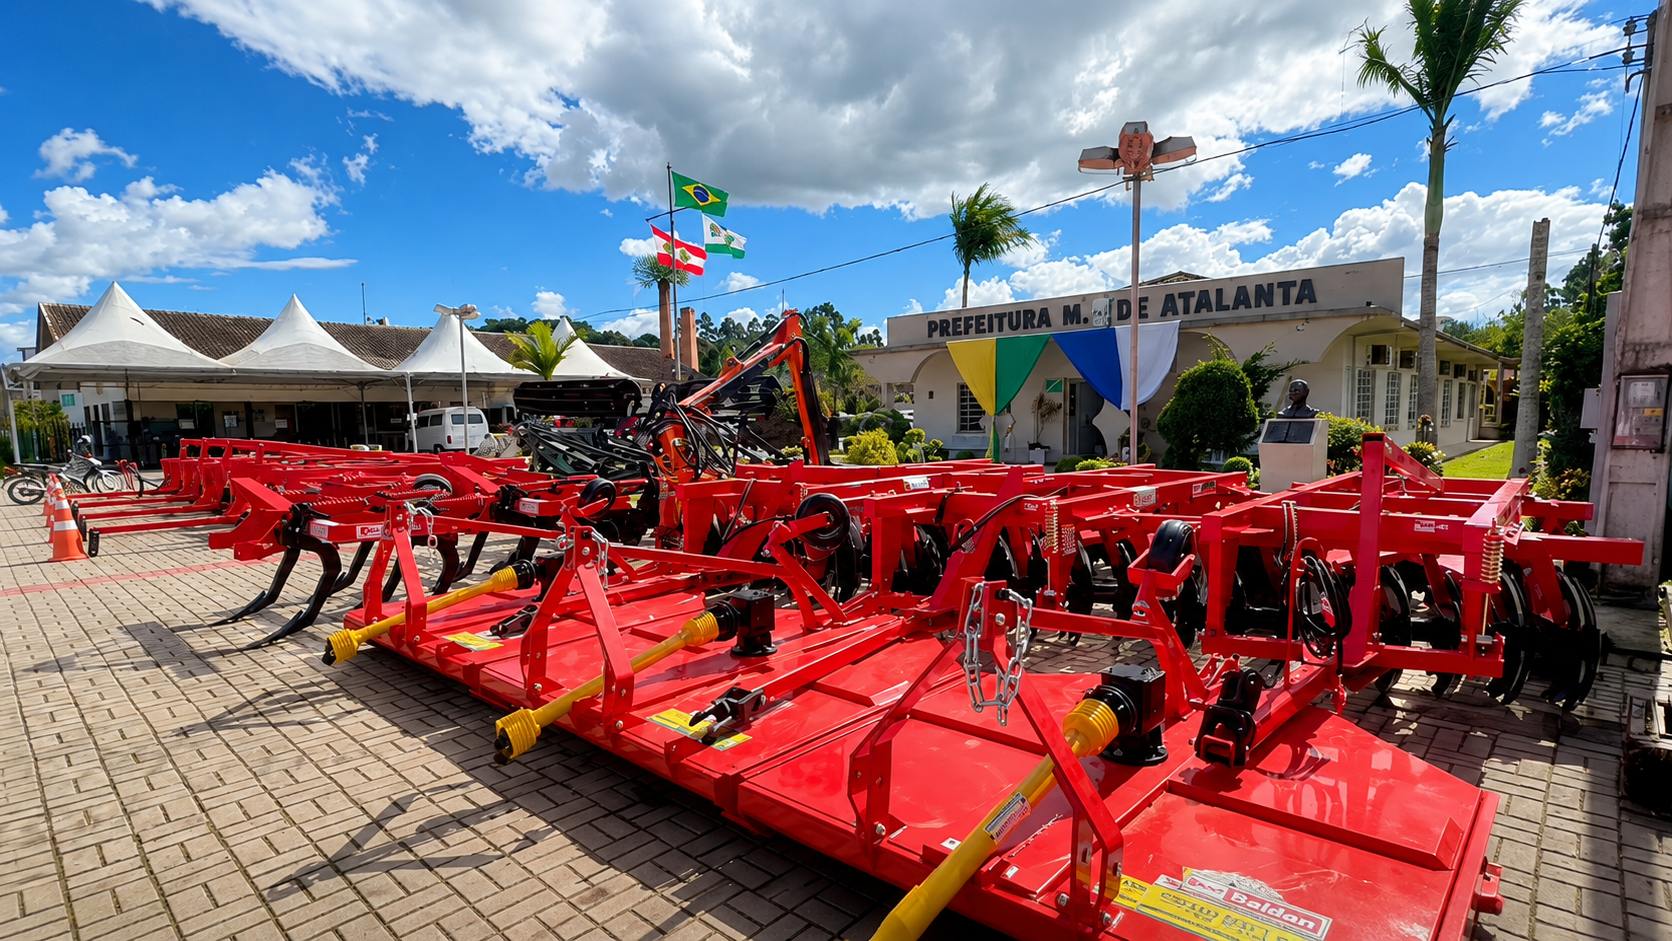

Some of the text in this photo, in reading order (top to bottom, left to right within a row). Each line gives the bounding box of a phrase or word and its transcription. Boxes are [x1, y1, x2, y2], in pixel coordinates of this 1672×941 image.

[927, 307, 1052, 338] PREFEITURA
[1062, 303, 1089, 326] M.
[1116, 296, 1149, 321] DE
[1160, 278, 1317, 317] ATALANTA
[1230, 890, 1317, 931] Baldan
